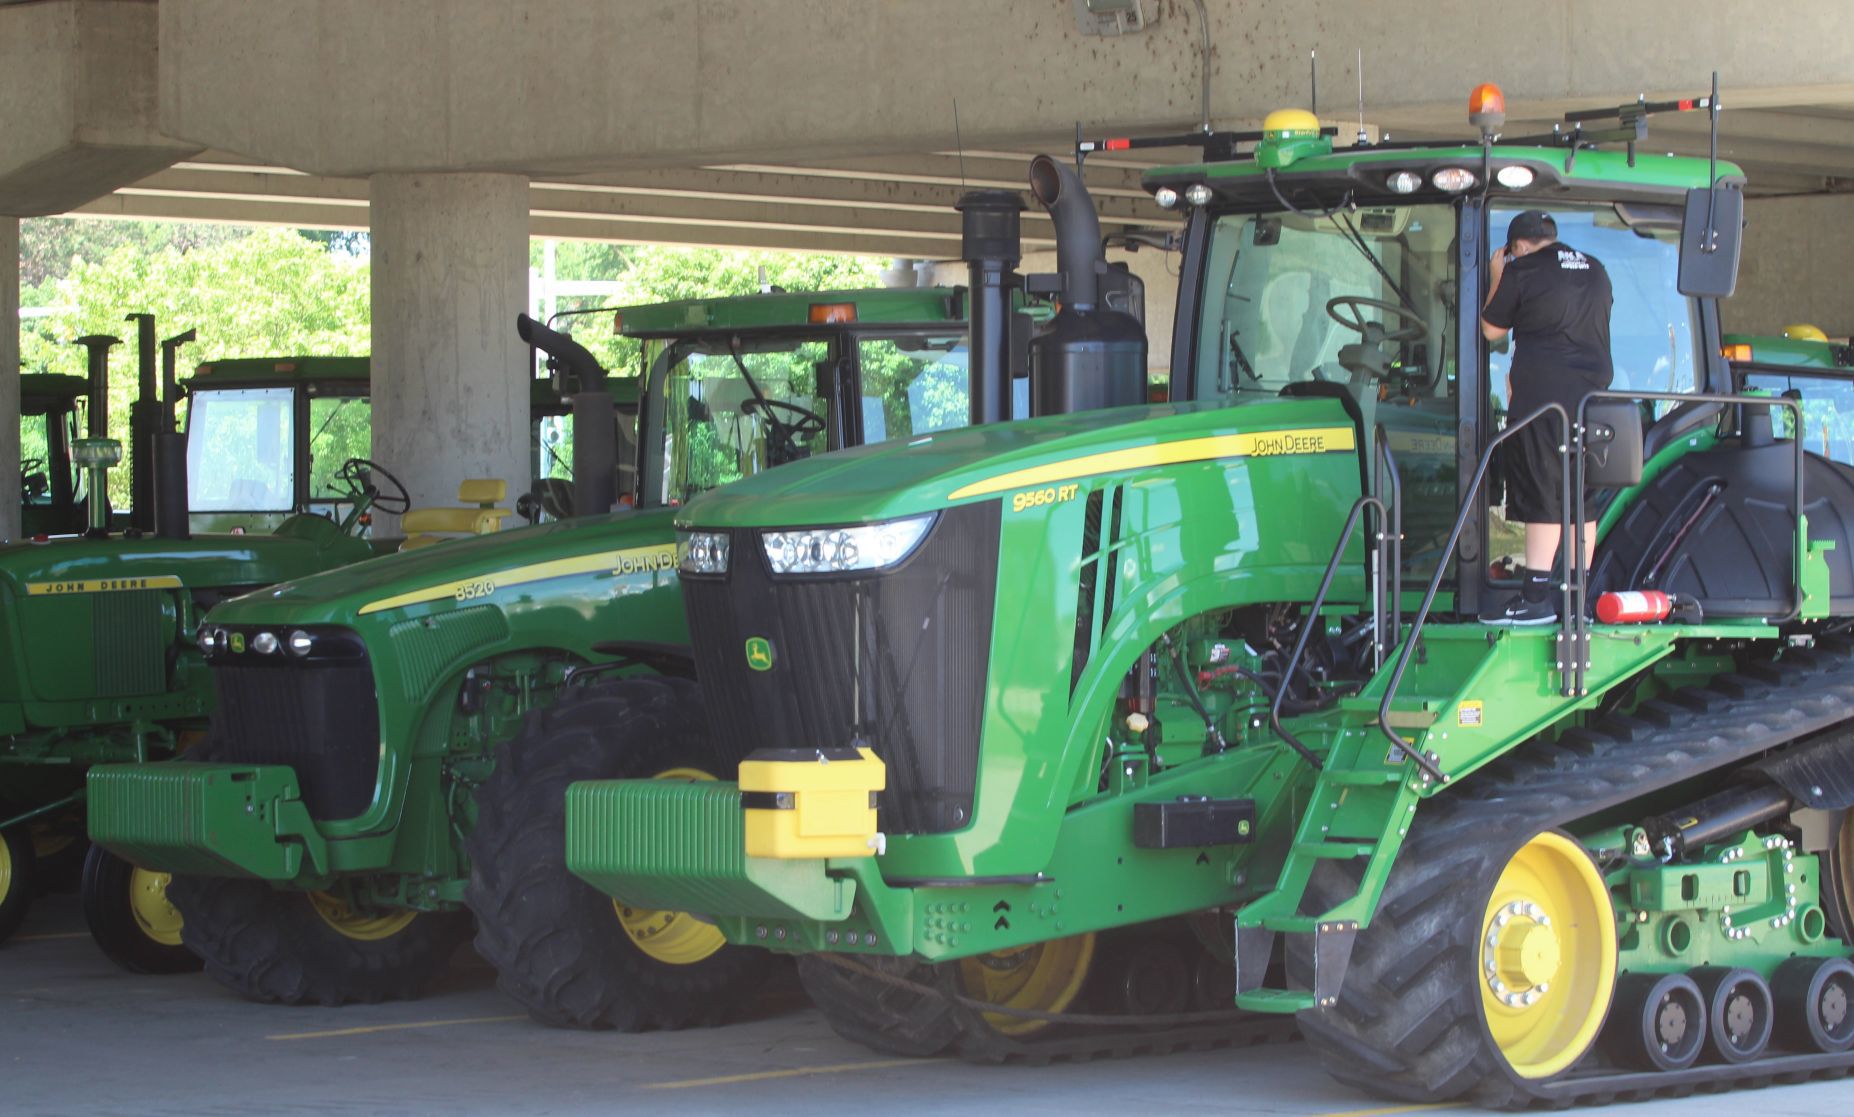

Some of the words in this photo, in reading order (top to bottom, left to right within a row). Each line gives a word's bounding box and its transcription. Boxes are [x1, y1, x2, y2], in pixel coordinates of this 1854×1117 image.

[1251, 437, 1283, 455] JOHN
[1284, 434, 1326, 453] DEERE
[1013, 488, 1055, 511] 9560
[1058, 484, 1078, 502] RT
[612, 554, 658, 575] JOHN
[45, 583, 85, 593] JOHN
[100, 579, 147, 590] DEERE
[456, 581, 495, 601] 8520
